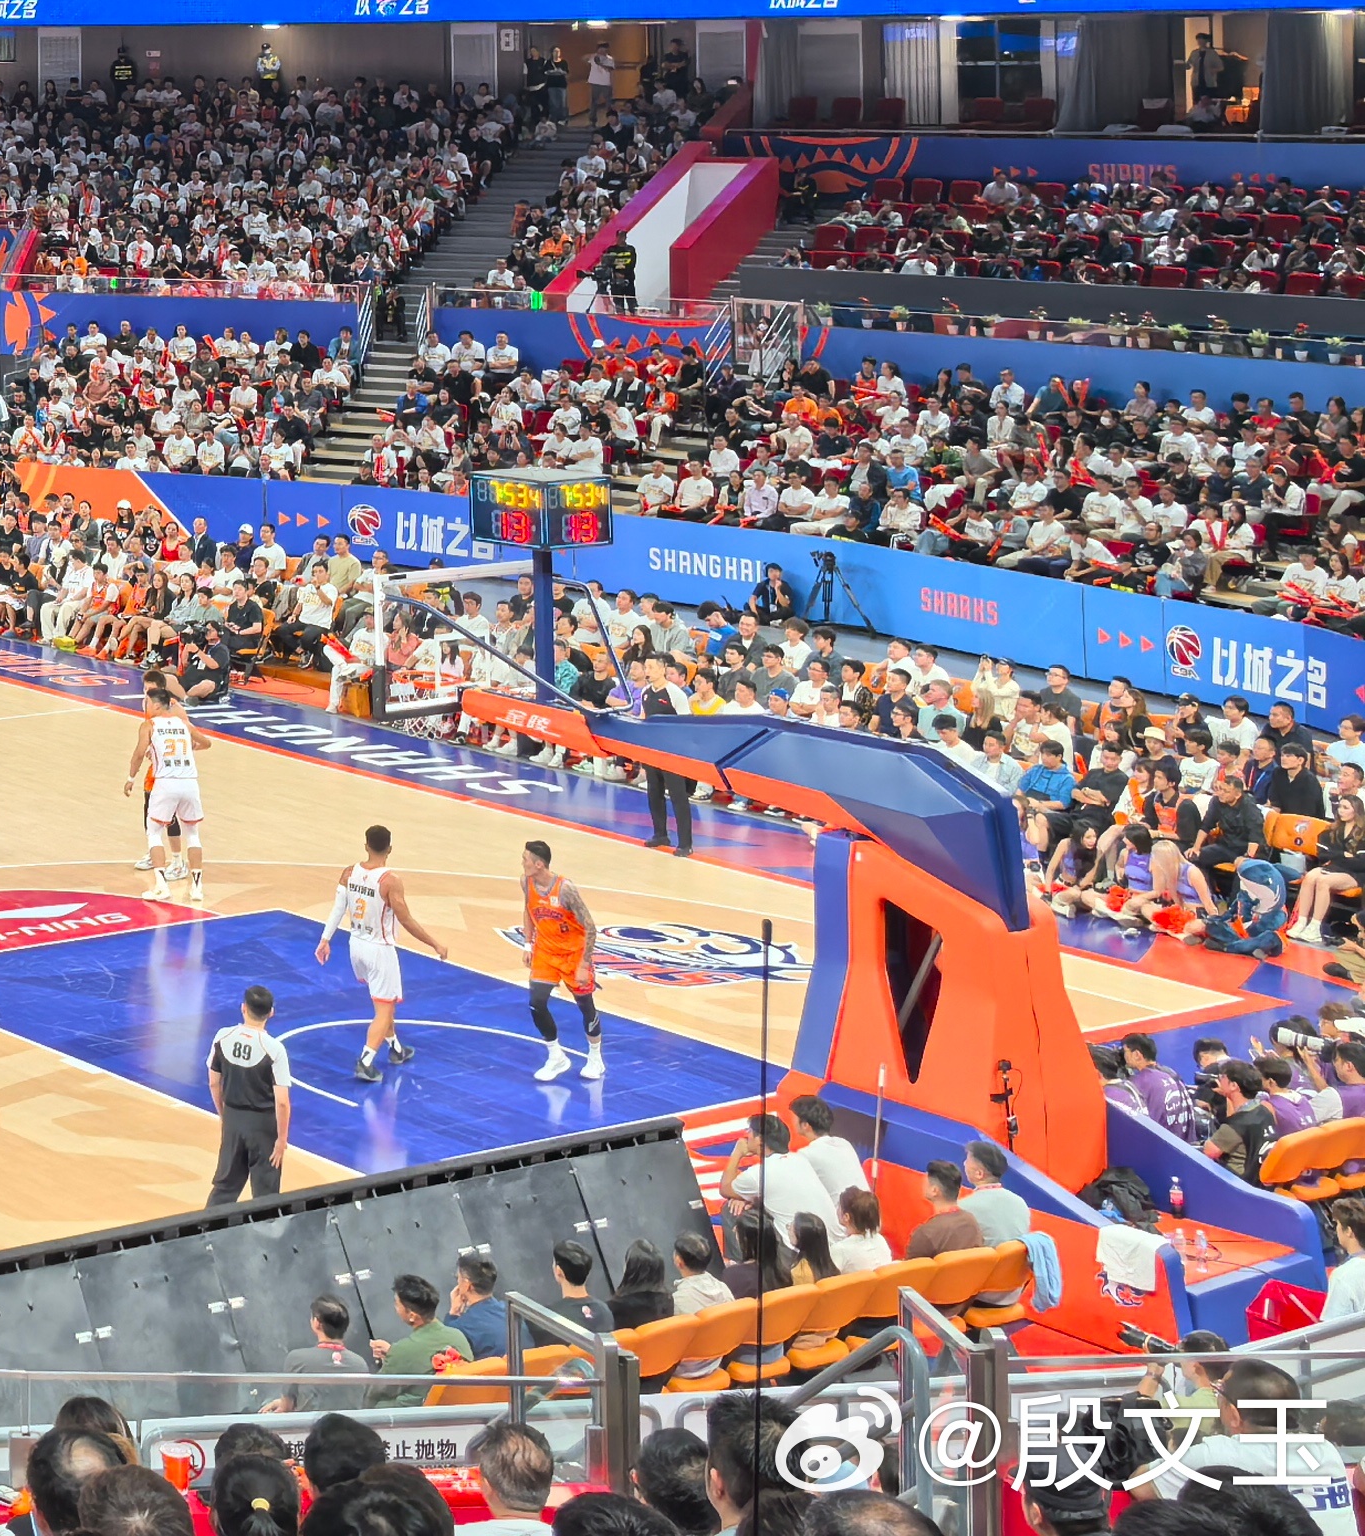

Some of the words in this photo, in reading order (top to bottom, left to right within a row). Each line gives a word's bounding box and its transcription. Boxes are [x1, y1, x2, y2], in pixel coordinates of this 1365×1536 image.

[500, 28, 514, 52] 8
[649, 546, 766, 586] SHANGHAI
[921, 587, 998, 626] SHARKS
[1212, 637, 1326, 709] 以城之名
[111, 693, 562, 796] SHANGHI
[163, 739, 187, 757] 37
[232, 1041, 253, 1061] 89
